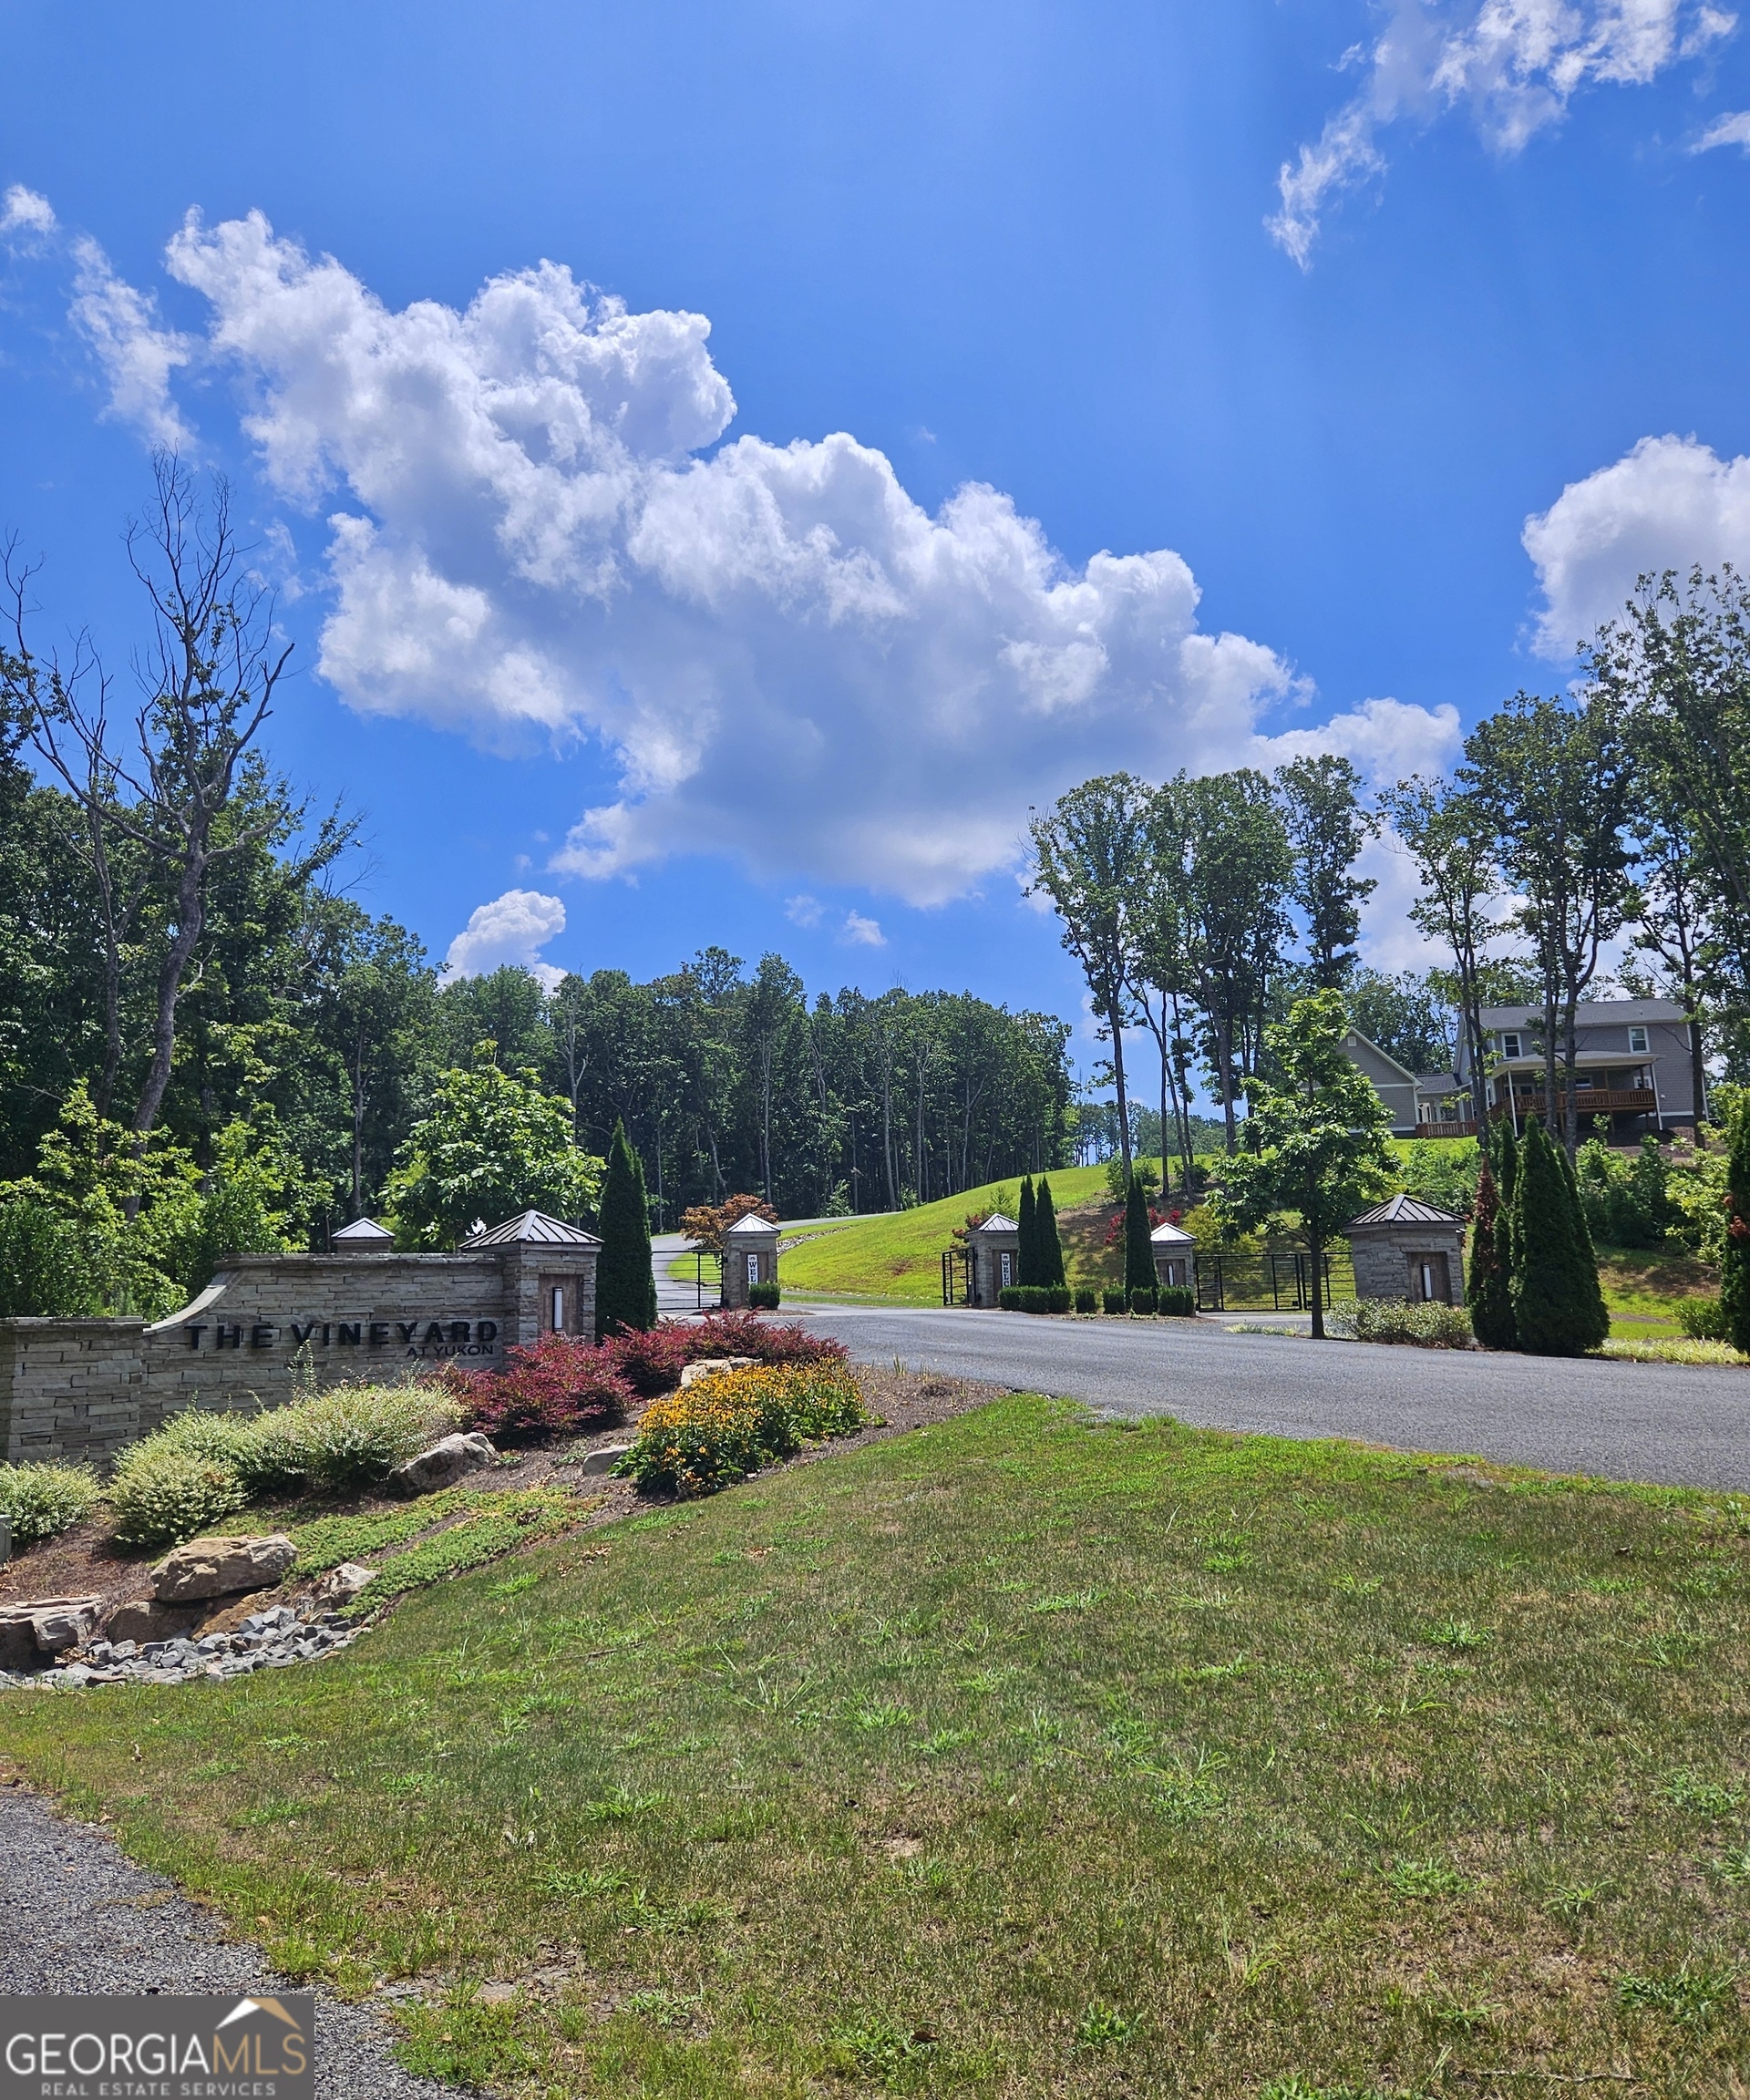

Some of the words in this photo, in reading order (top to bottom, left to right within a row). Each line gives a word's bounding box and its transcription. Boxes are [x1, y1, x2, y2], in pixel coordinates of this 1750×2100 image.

[748, 1261, 757, 1286] WEL
[184, 1324, 273, 1350] THE
[290, 1321, 498, 1347] VINEYARD
[407, 1346, 429, 1358] AT
[434, 1344, 494, 1357] YUKON
